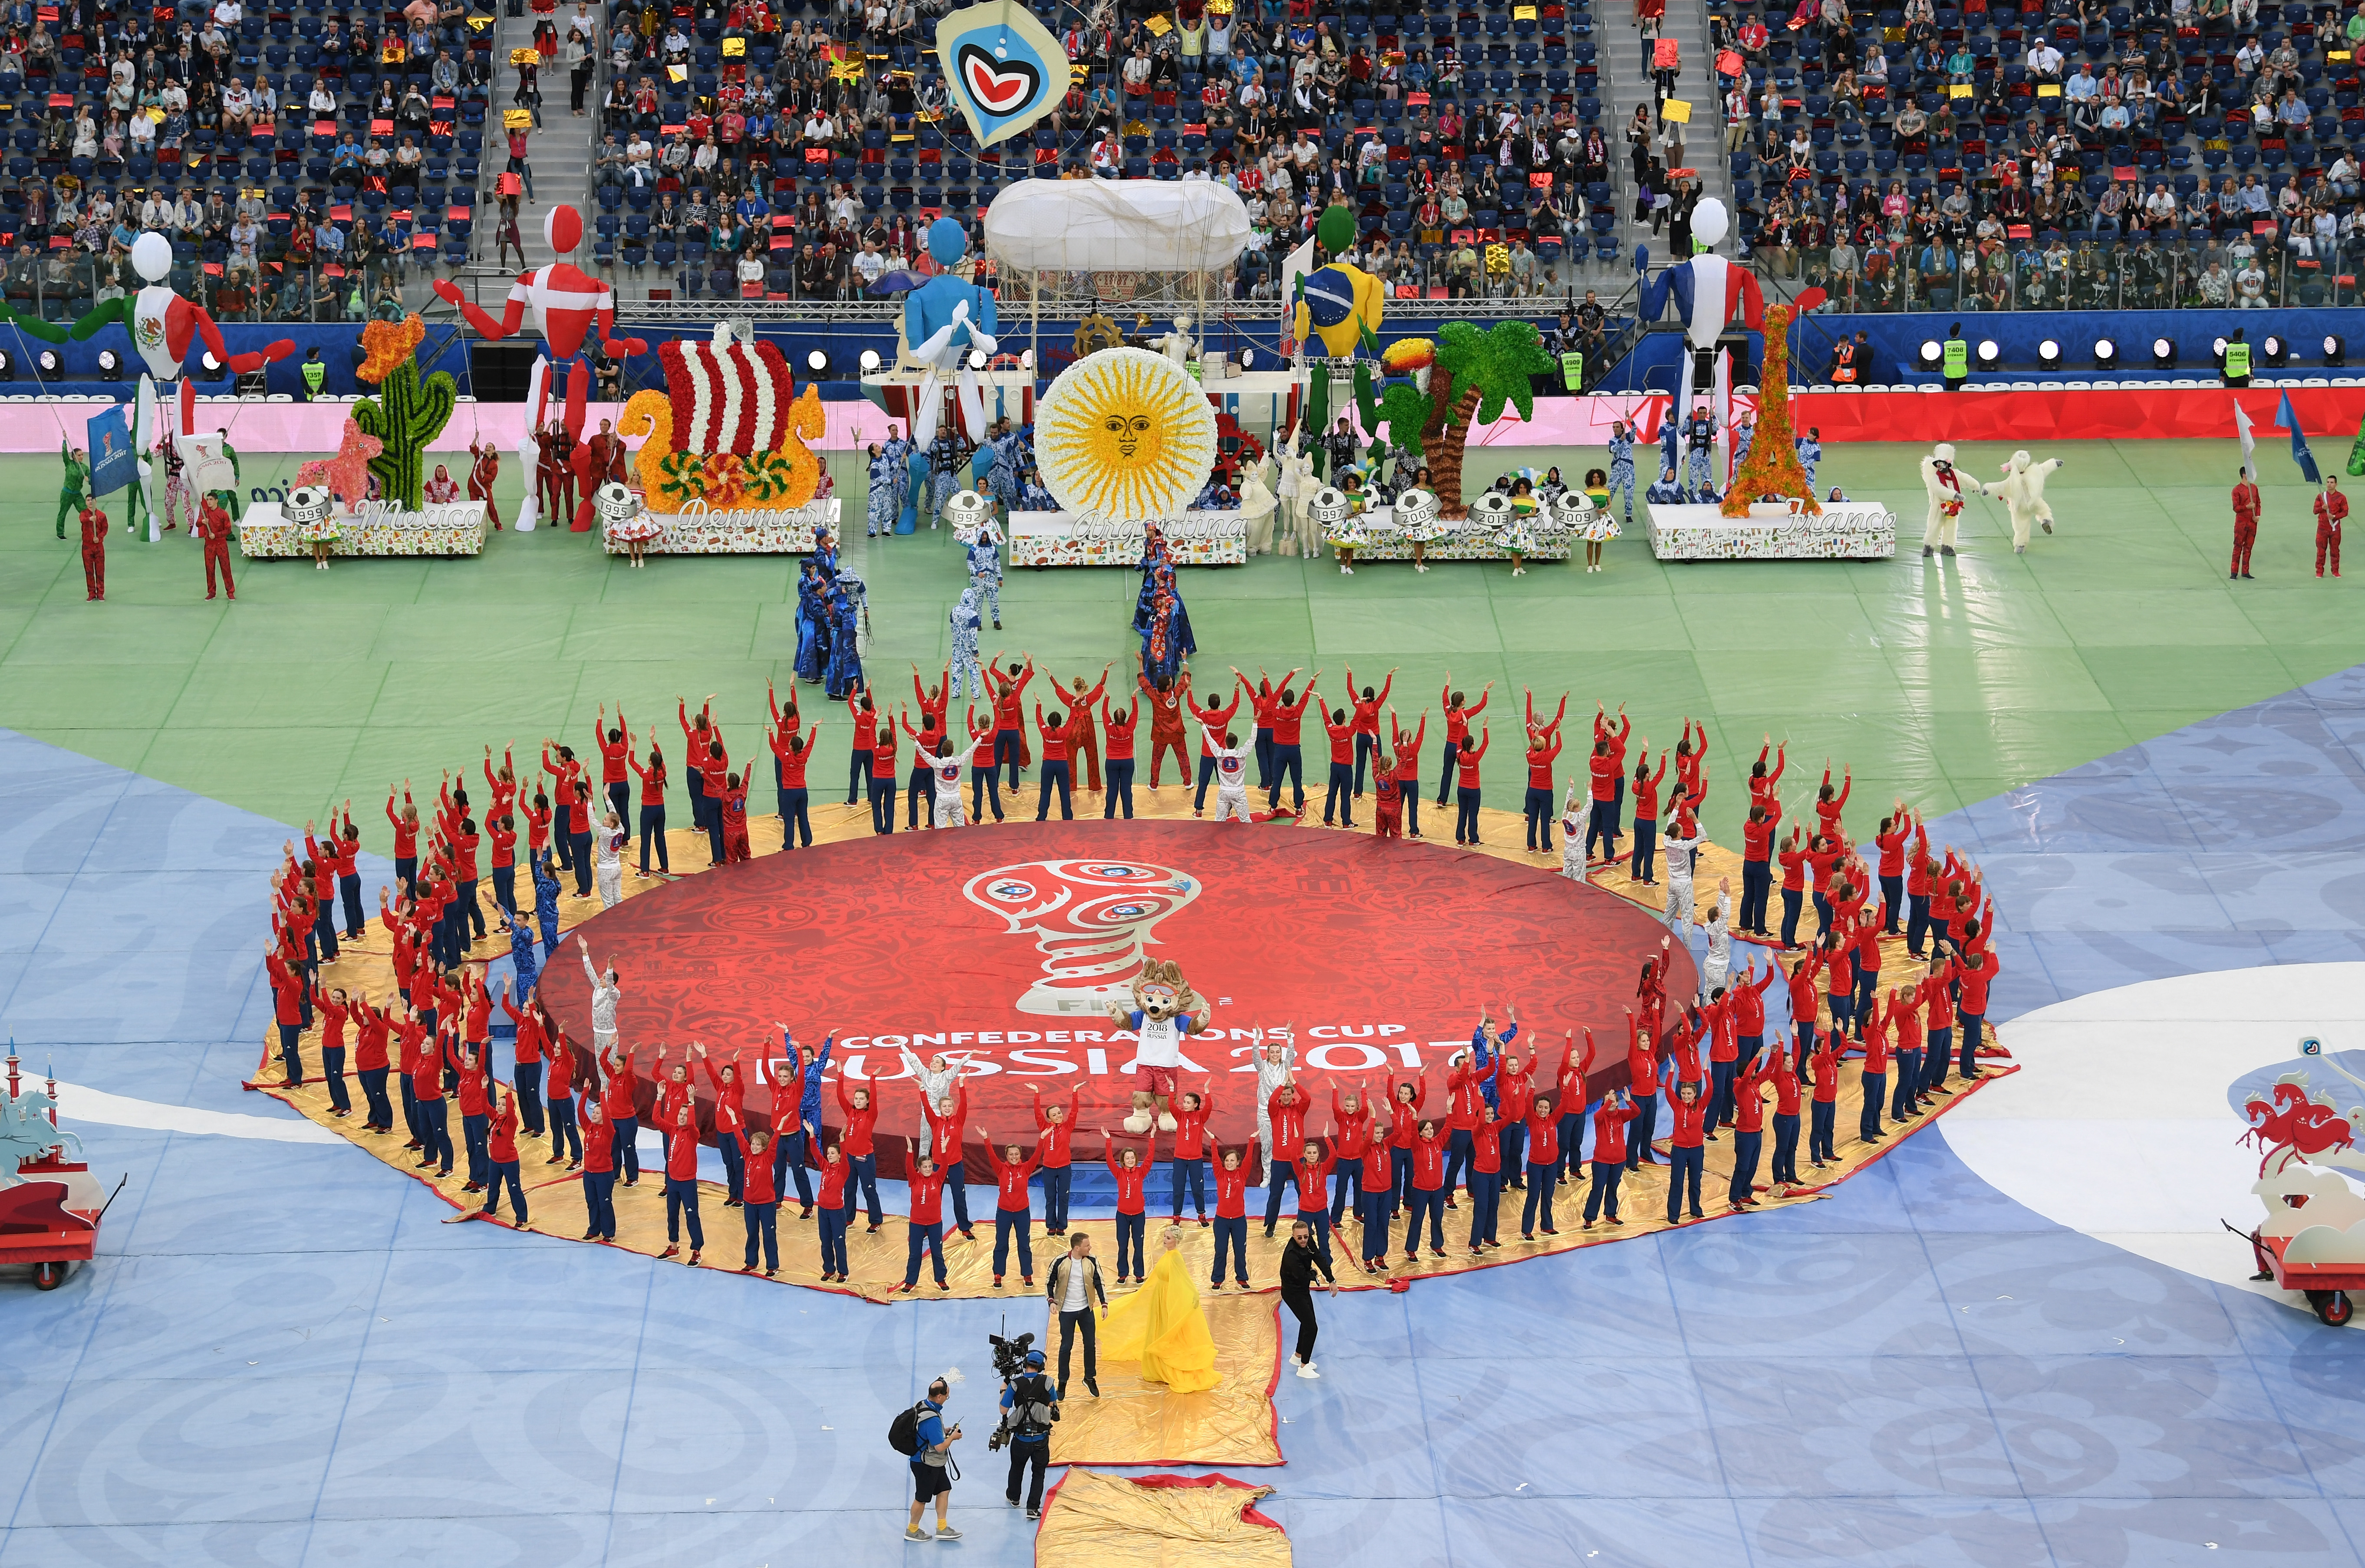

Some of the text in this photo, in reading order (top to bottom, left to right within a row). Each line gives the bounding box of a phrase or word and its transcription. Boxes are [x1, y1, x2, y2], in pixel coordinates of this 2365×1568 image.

[95, 458, 115, 473] RUSSIA
[114, 450, 127, 460] 2017
[292, 508, 323, 520] 1999
[354, 498, 481, 531] Mexico
[600, 501, 627, 516] 1995
[677, 495, 839, 530] Denmark
[1317, 509, 1344, 520] 1997
[1401, 506, 1434, 524] 2005
[952, 512, 981, 523] 1992
[1478, 513, 1509, 524] 2013
[1558, 511, 1591, 523] 2009
[1777, 497, 1897, 536] France
[1057, 999, 1142, 1012] FIF
[1147, 1023, 1168, 1032] 2018
[840, 1024, 1407, 1049] CONFEDERAONS CUP
